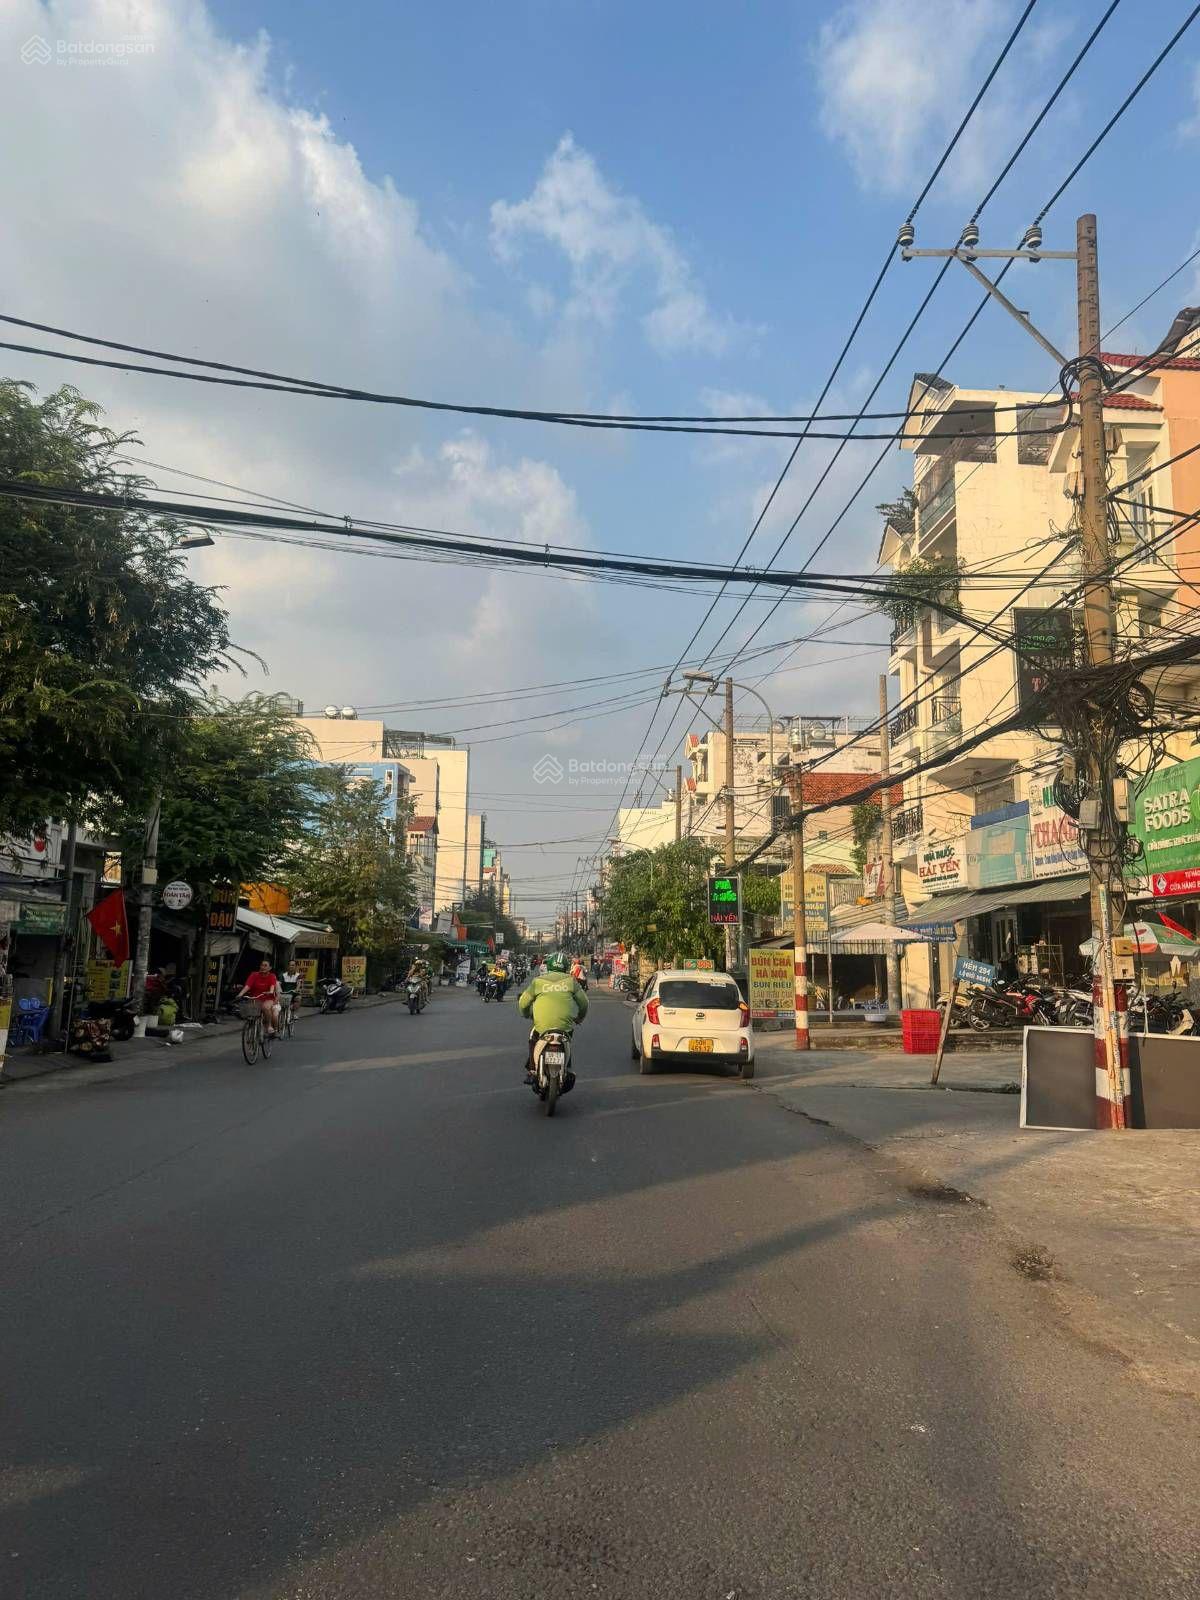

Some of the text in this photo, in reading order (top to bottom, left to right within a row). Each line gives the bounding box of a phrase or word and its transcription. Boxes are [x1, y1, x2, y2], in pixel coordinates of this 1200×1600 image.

[1144, 788, 1190, 814] SATRA
[1145, 806, 1190, 833] FOODS
[938, 857, 960, 873] YẾN
[1181, 880, 1196, 890] HÀNG
[542, 982, 569, 993] Grab
